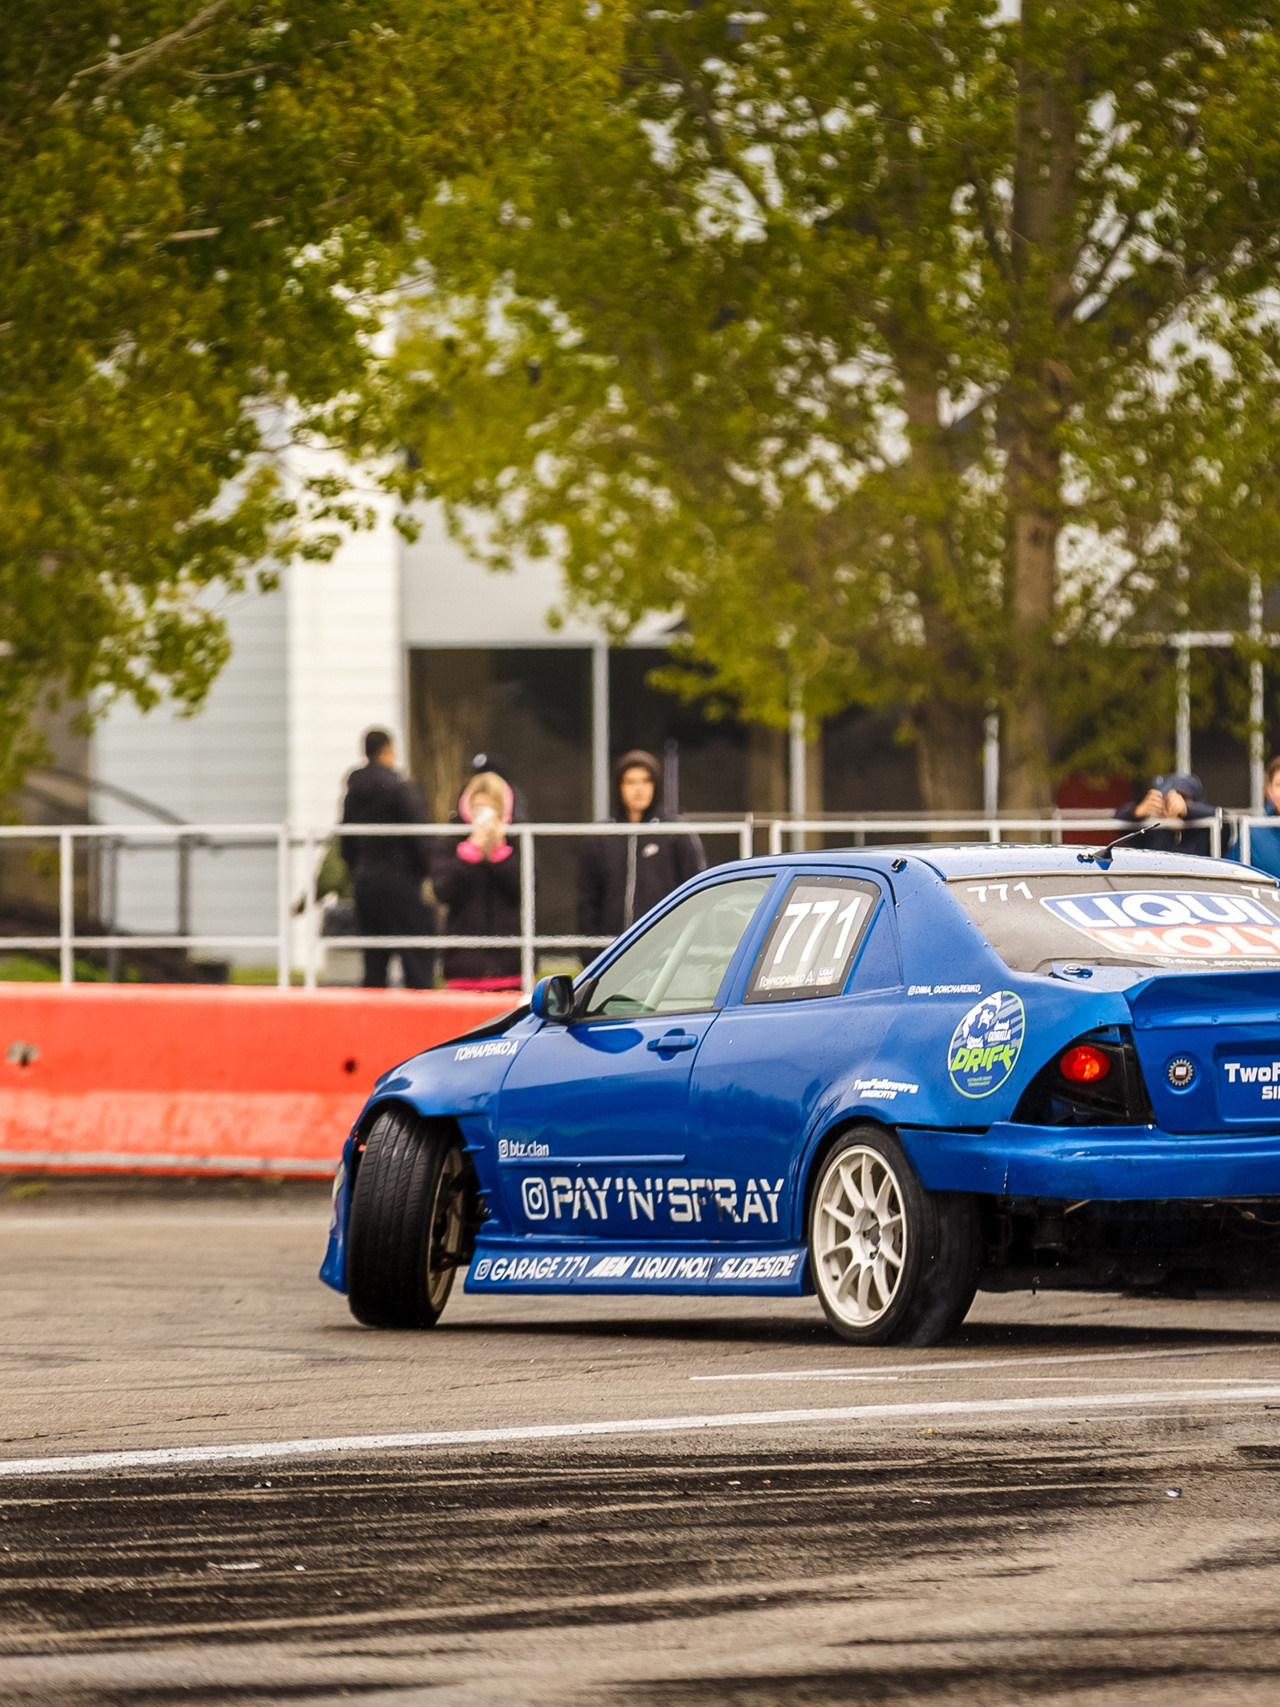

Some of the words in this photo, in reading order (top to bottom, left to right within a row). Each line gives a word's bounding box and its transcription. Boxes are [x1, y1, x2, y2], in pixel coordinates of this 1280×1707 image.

[966, 881, 1034, 903] 771
[1056, 894, 1274, 928] LIQUI
[773, 897, 862, 965] 771
[454, 1041, 511, 1062] ГОНЧАРЕНКО
[950, 1044, 1016, 1074] DRIFT
[509, 1140, 550, 1157] btz.clan
[490, 1256, 562, 1281] GARAGE
[557, 1255, 591, 1279] 771
[630, 1256, 679, 1280] LIQUI
[675, 1256, 722, 1279] MOLY
[714, 1253, 800, 1279] SLIDESIDE
